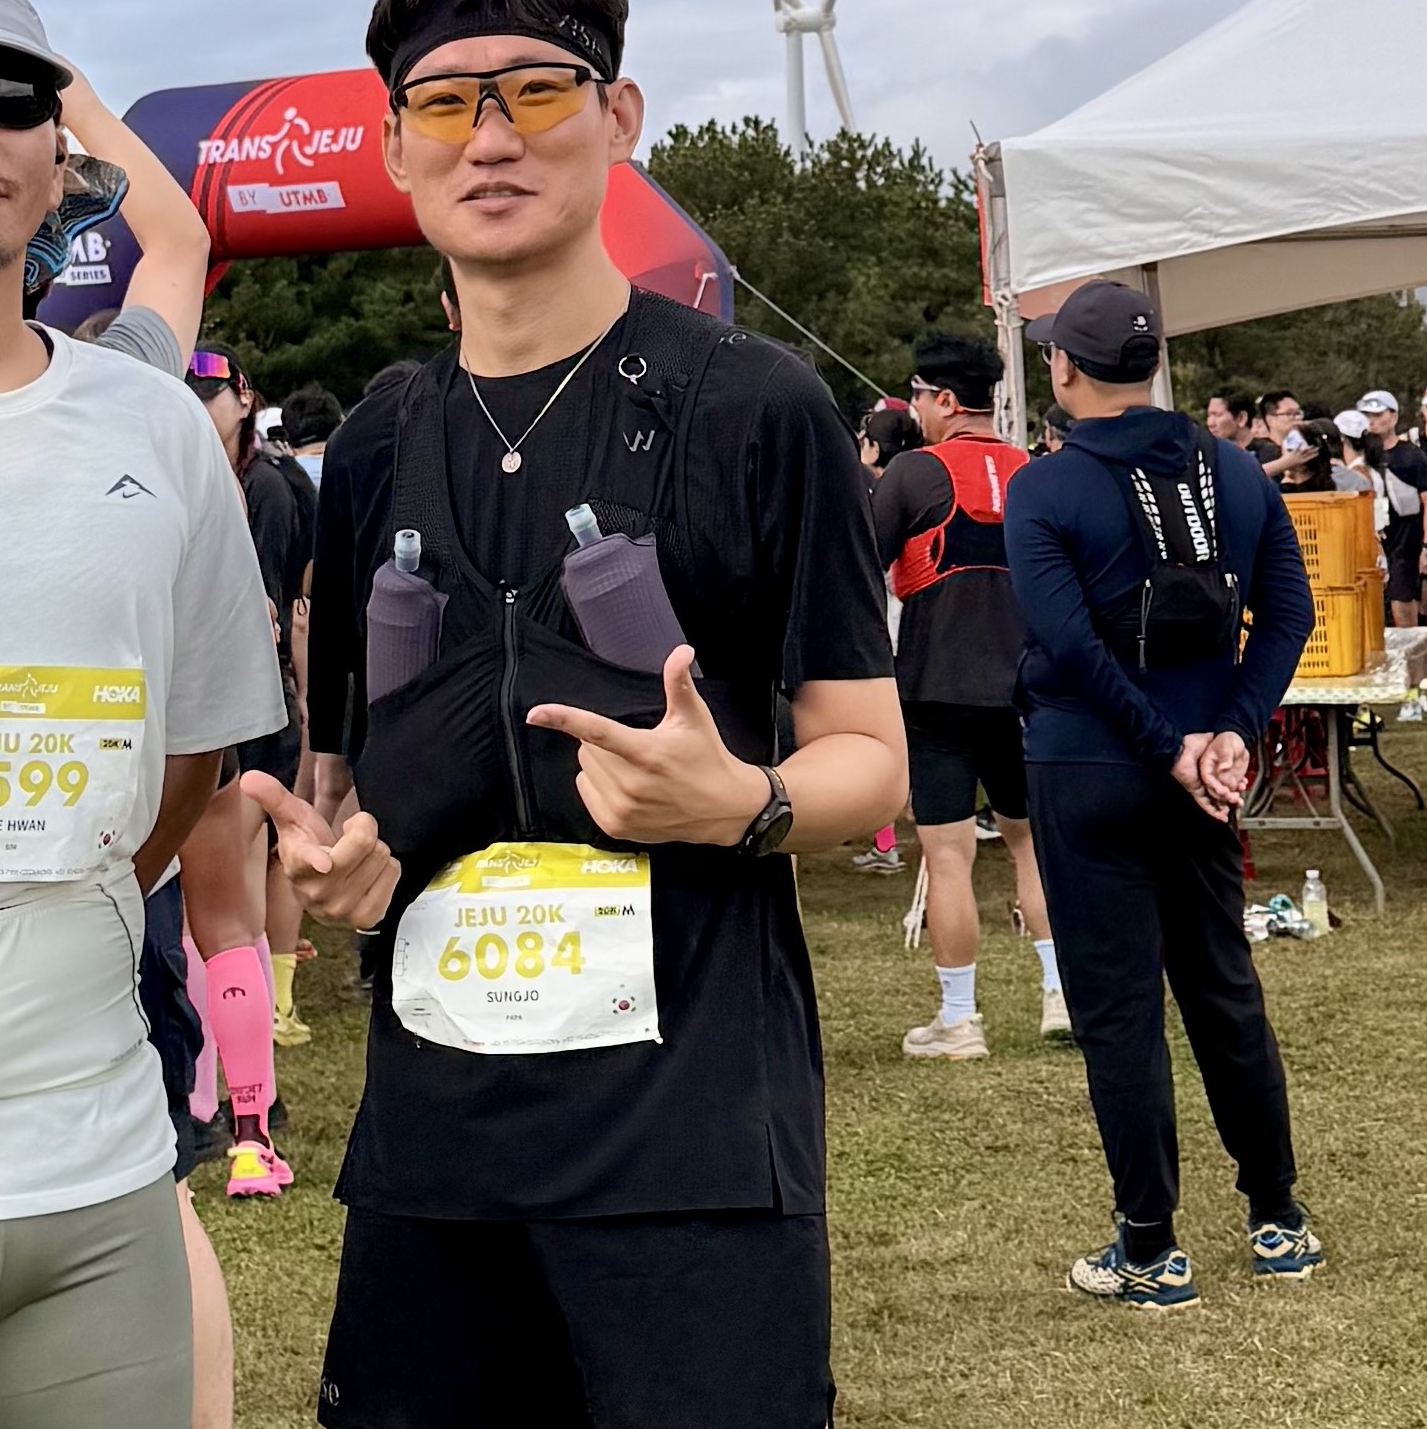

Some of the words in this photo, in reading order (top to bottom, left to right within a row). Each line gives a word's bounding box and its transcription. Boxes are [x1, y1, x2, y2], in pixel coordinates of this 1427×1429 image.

[197, 134, 274, 165] TRANS
[306, 126, 364, 155] JEJU
[238, 188, 258, 206] BY
[280, 187, 329, 208] UTMB
[1177, 482, 1211, 562] OUTDOOR
[93, 685, 141, 703] HOKA
[29, 733, 75, 754] 20K
[7, 820, 46, 831] HWAN
[580, 859, 638, 874] HOKA
[454, 906, 508, 928] JEJU
[516, 904, 565, 926] 20K
[438, 931, 586, 981] 6084
[487, 990, 539, 1003] SUNGJO
